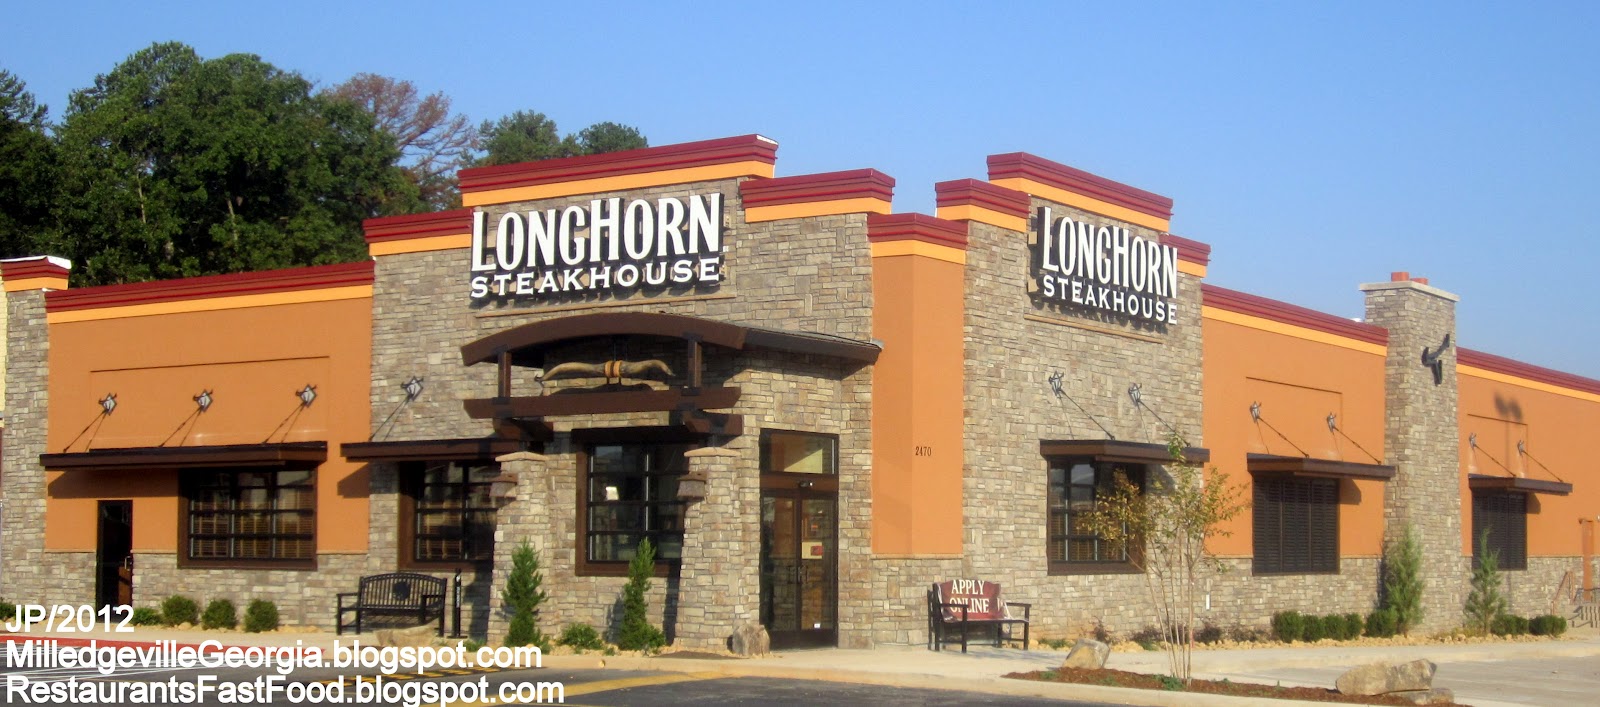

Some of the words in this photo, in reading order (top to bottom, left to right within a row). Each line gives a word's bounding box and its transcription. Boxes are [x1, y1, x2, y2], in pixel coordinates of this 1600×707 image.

[471, 192, 721, 272] LONGHORN
[1043, 206, 1178, 299] LONGHORN
[470, 257, 720, 298] STEAKHOUSE
[1043, 274, 1178, 325] STEAKHOUSE
[915, 446, 932, 456] 2470
[949, 597, 990, 613] ONLINE
[951, 579, 985, 595] APPLY
